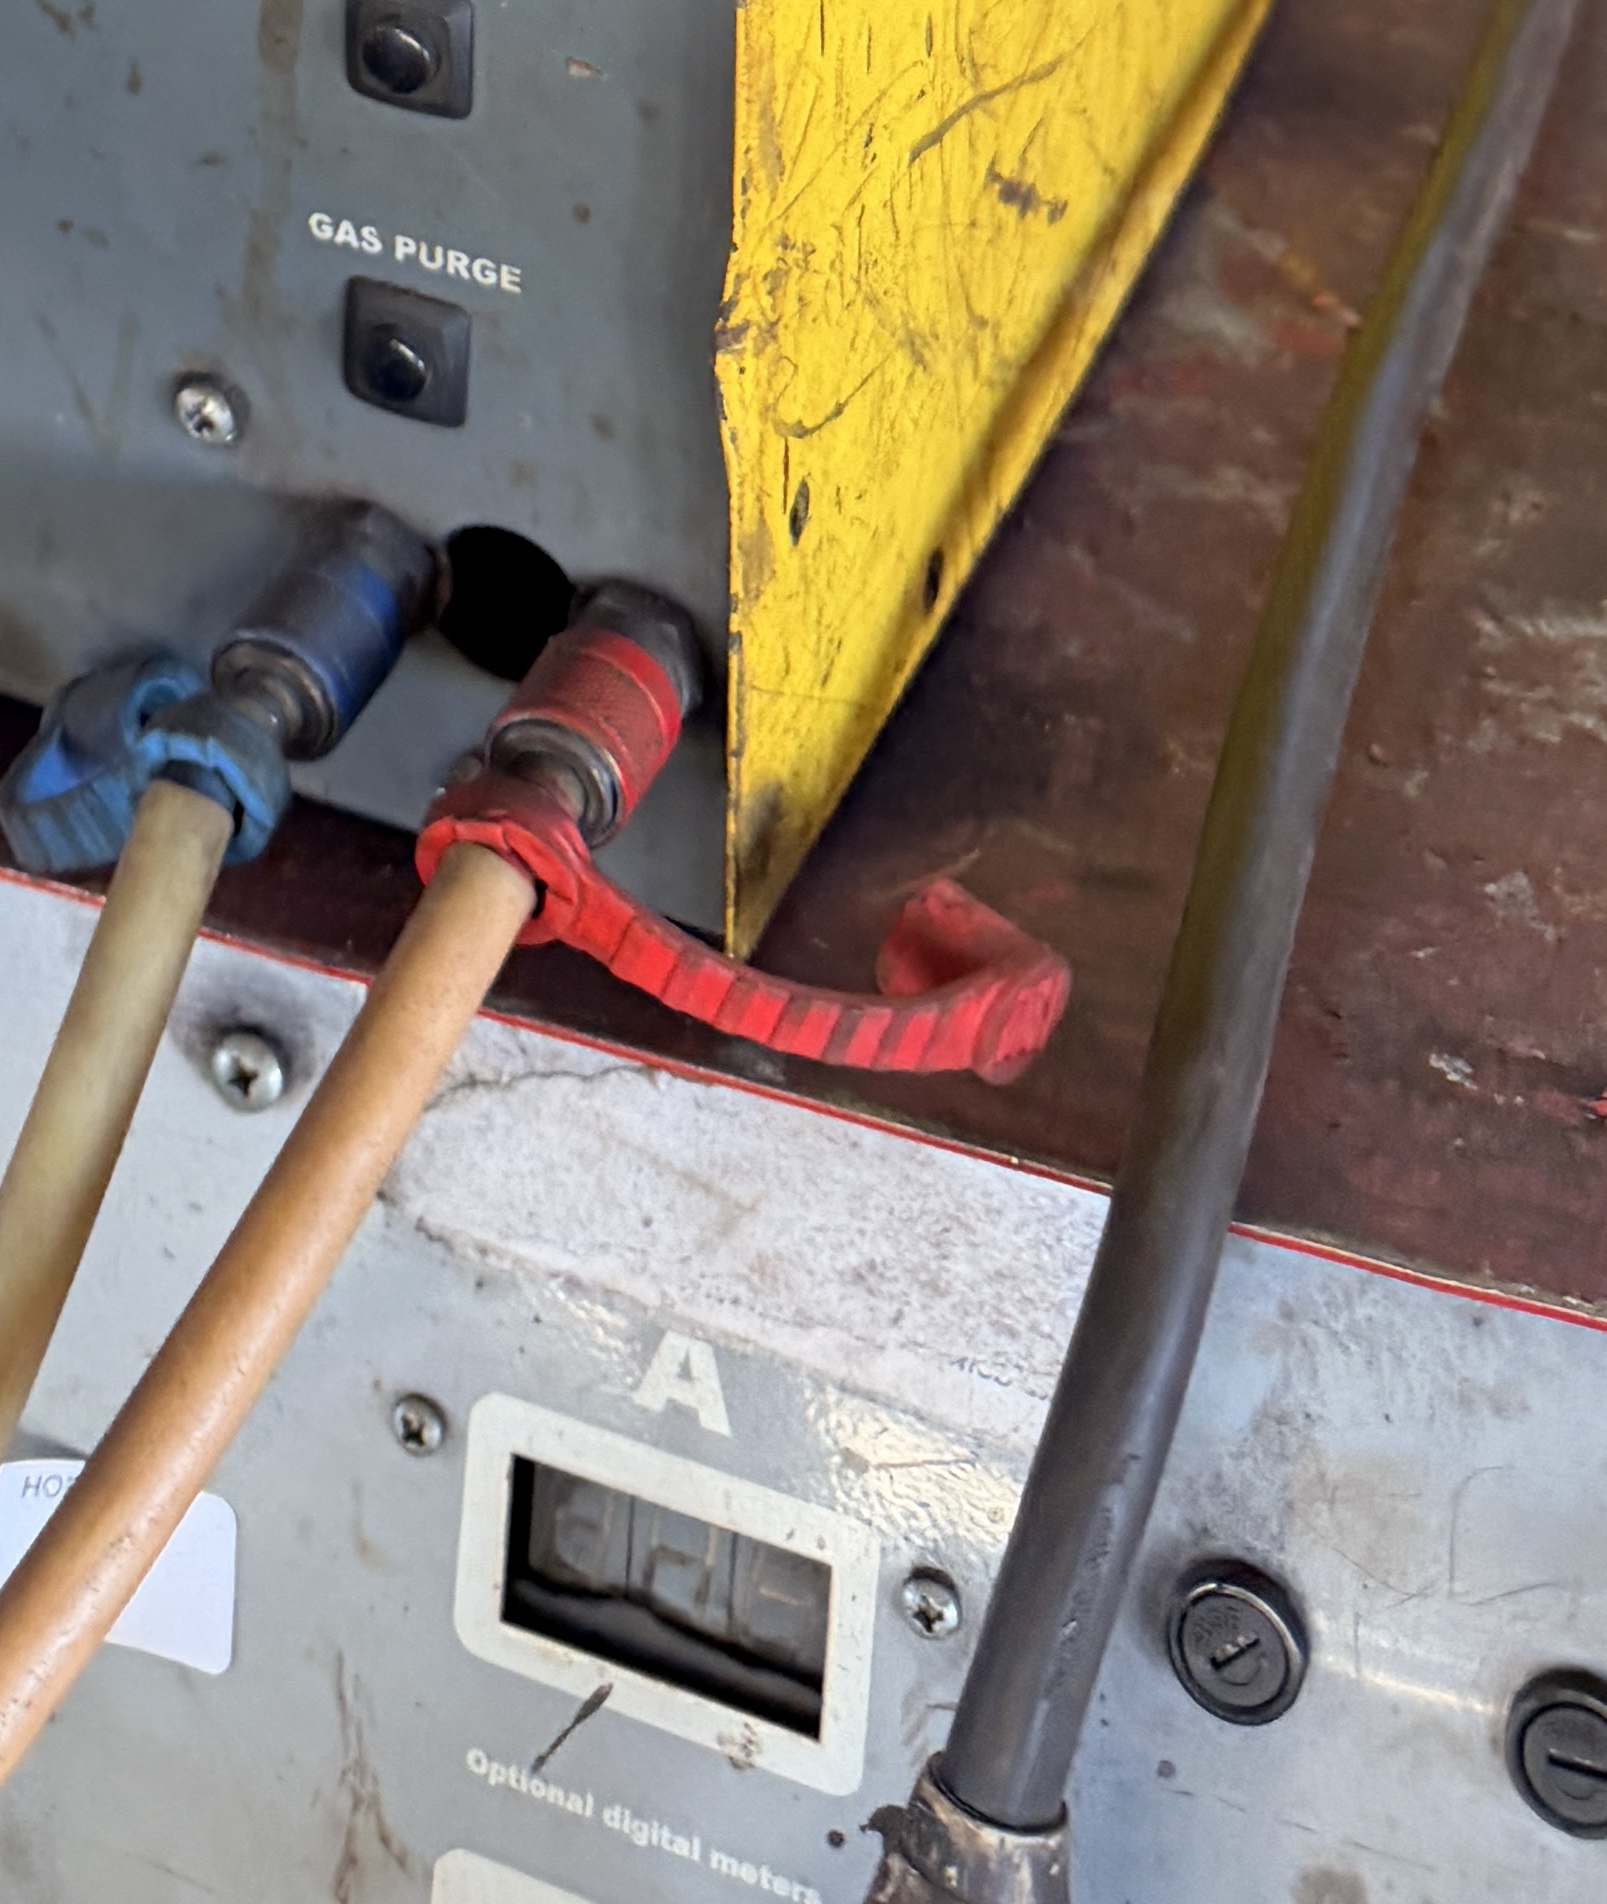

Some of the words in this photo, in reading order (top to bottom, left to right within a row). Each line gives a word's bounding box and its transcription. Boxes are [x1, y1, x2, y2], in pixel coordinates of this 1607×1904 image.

[308, 211, 383, 254] GAS
[394, 234, 522, 294] PURGE
[631, 1330, 732, 1439] A
[465, 1747, 594, 1819] Optional
[601, 1804, 702, 1863] digital
[709, 1847, 823, 1904] meters
